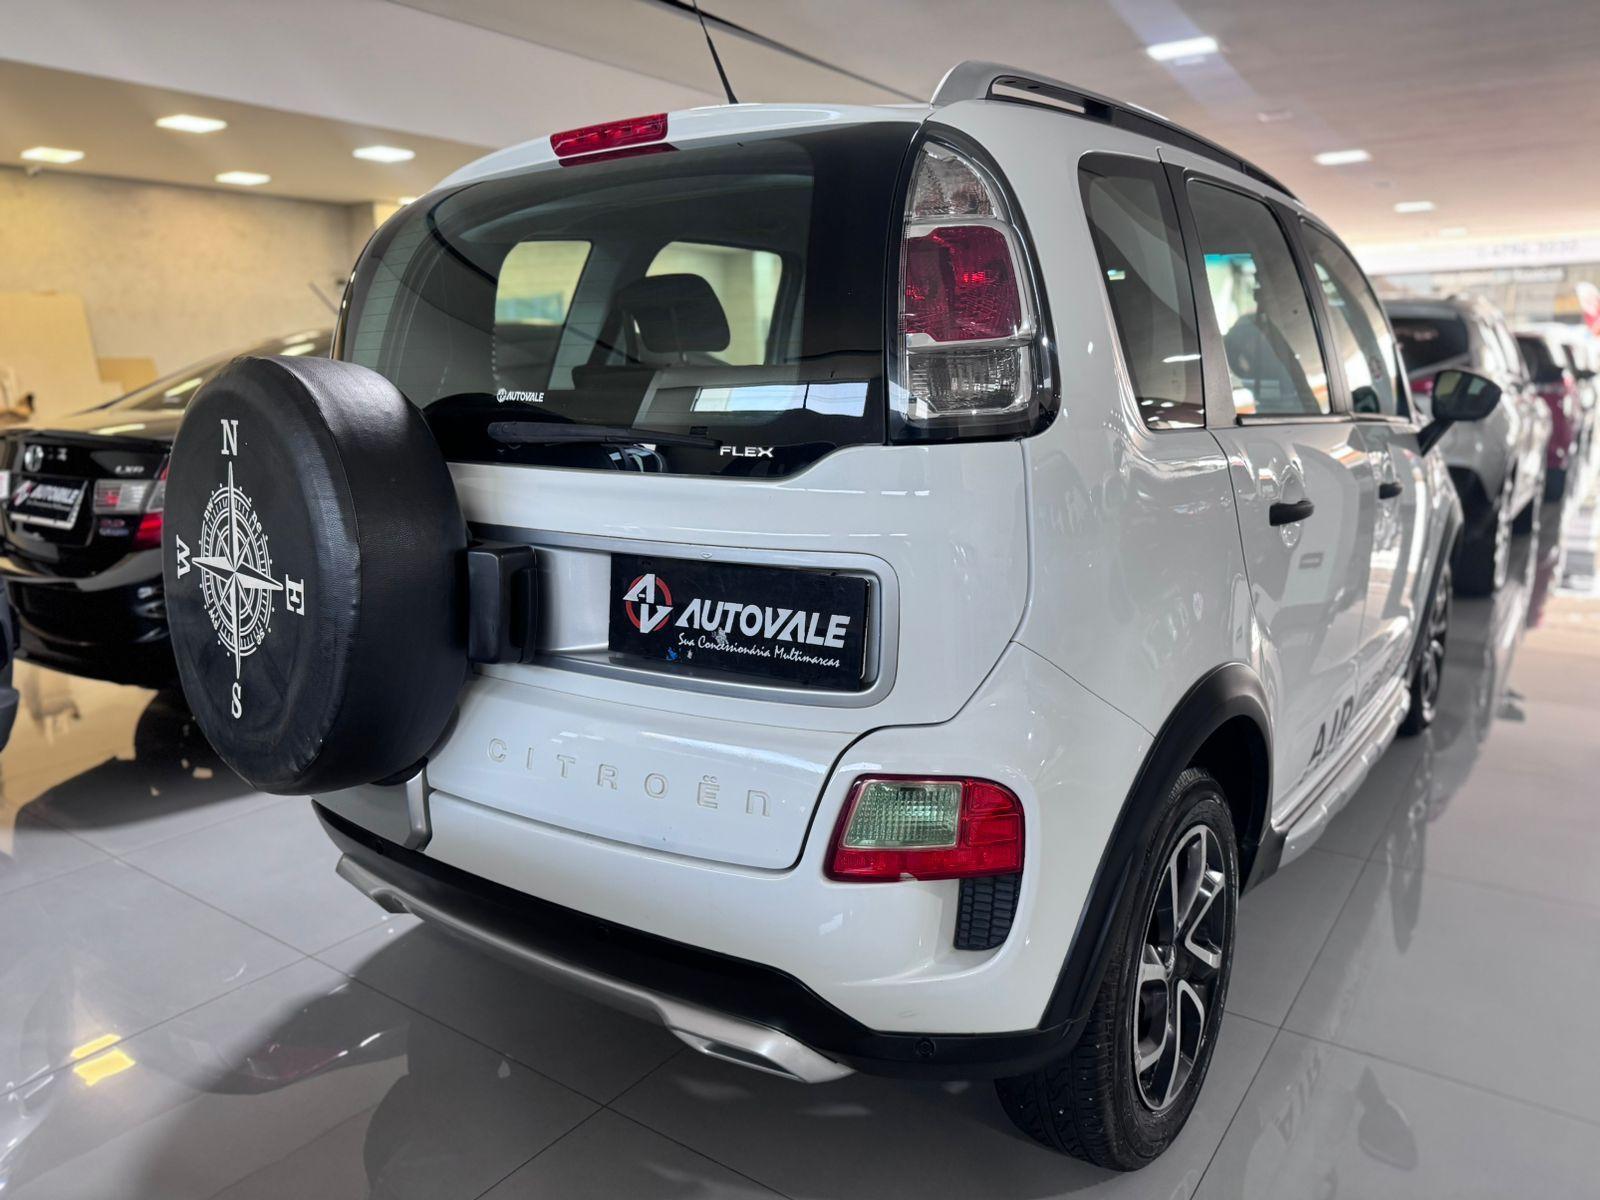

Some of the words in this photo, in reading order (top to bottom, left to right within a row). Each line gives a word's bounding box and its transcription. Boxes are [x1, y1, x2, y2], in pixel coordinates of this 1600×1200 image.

[506, 391, 545, 402] AUTOVALE
[221, 419, 239, 456] N
[719, 446, 775, 458] FLEX
[176, 535, 191, 579] W
[285, 574, 305, 616] E
[674, 598, 850, 648] AUTOVALE
[678, 632, 695, 648] Sua
[697, 635, 771, 658] Concessionária
[774, 648, 841, 668] Multimarcas
[231, 682, 243, 719] S
